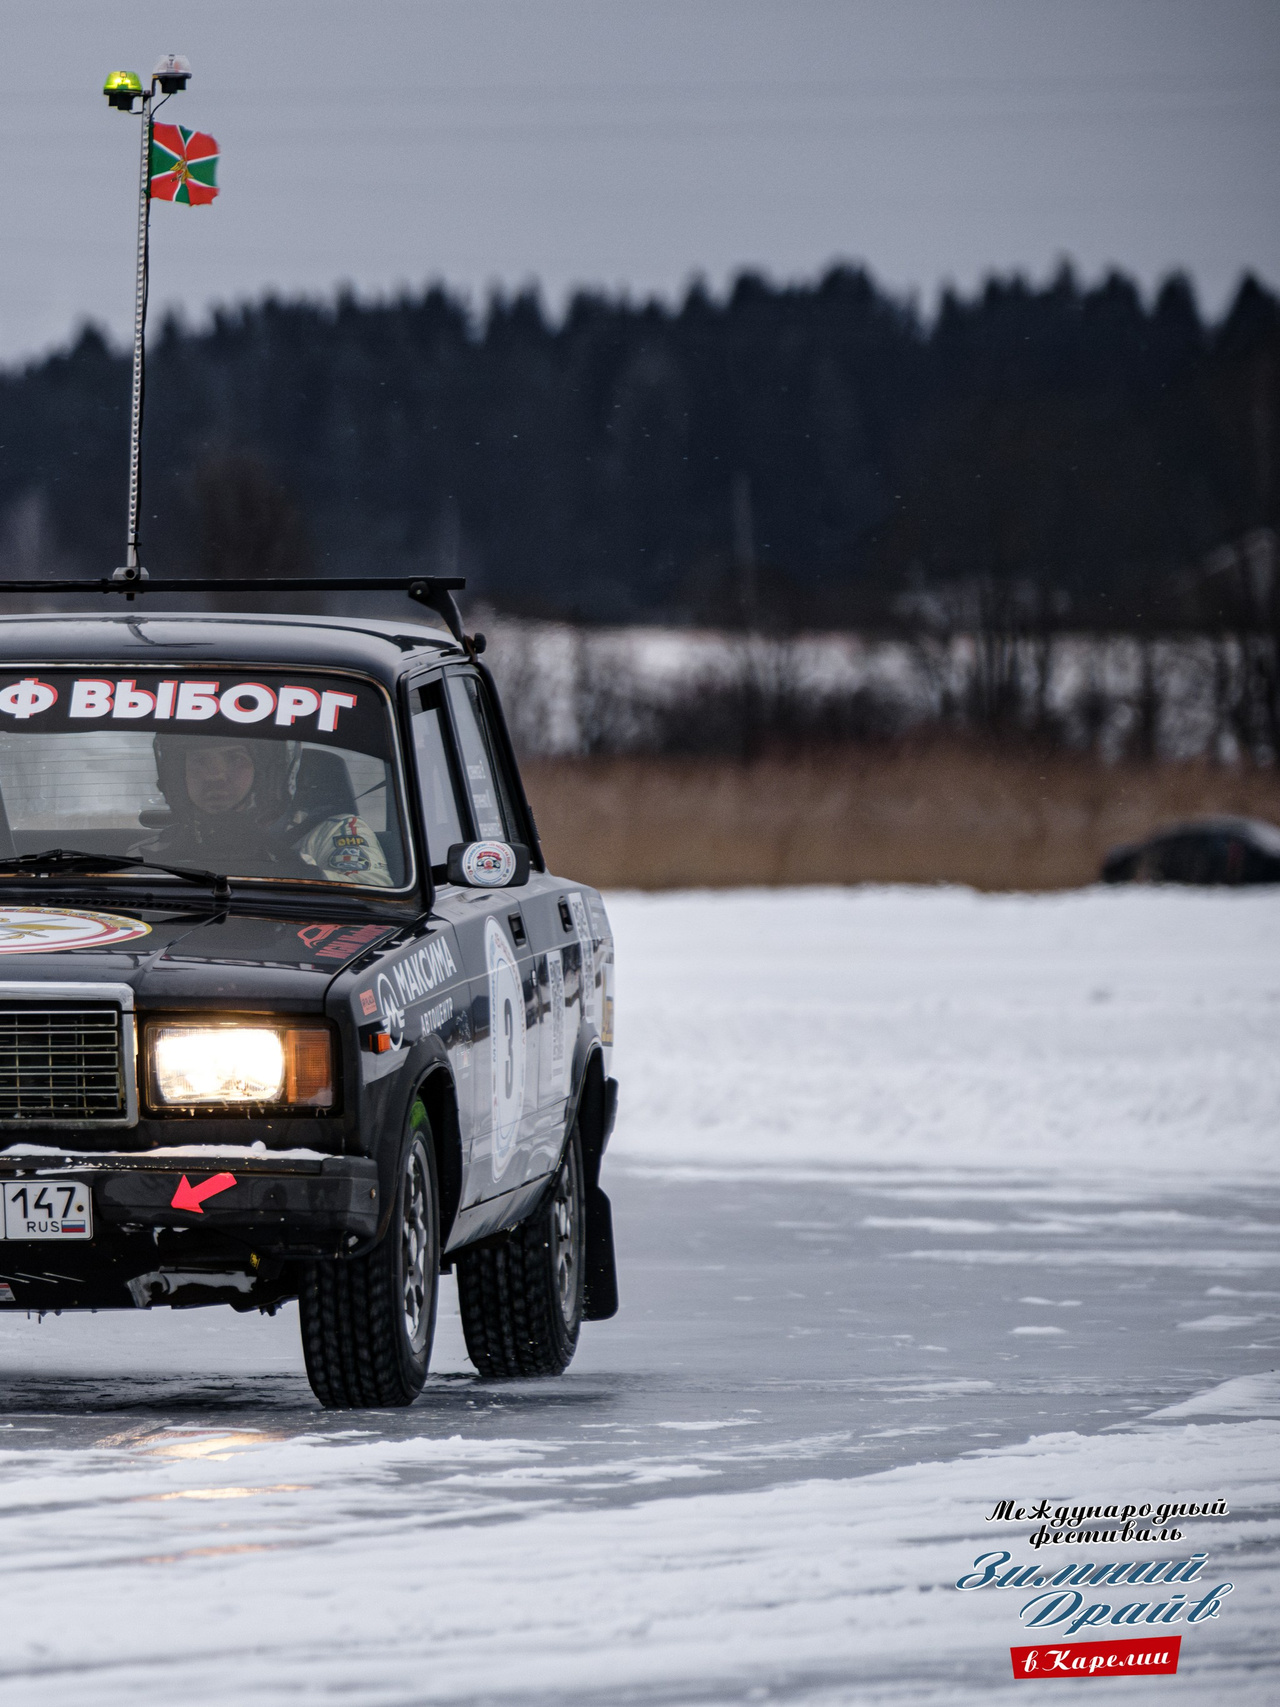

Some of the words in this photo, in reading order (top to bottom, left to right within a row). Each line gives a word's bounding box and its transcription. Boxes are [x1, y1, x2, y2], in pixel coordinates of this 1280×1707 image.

[69, 679, 357, 732] ВЫБОРГ
[393, 936, 457, 1005] МАКСИМА
[504, 998, 513, 1099] 3
[11, 1187, 76, 1219] 147
[27, 1221, 60, 1233] RUS
